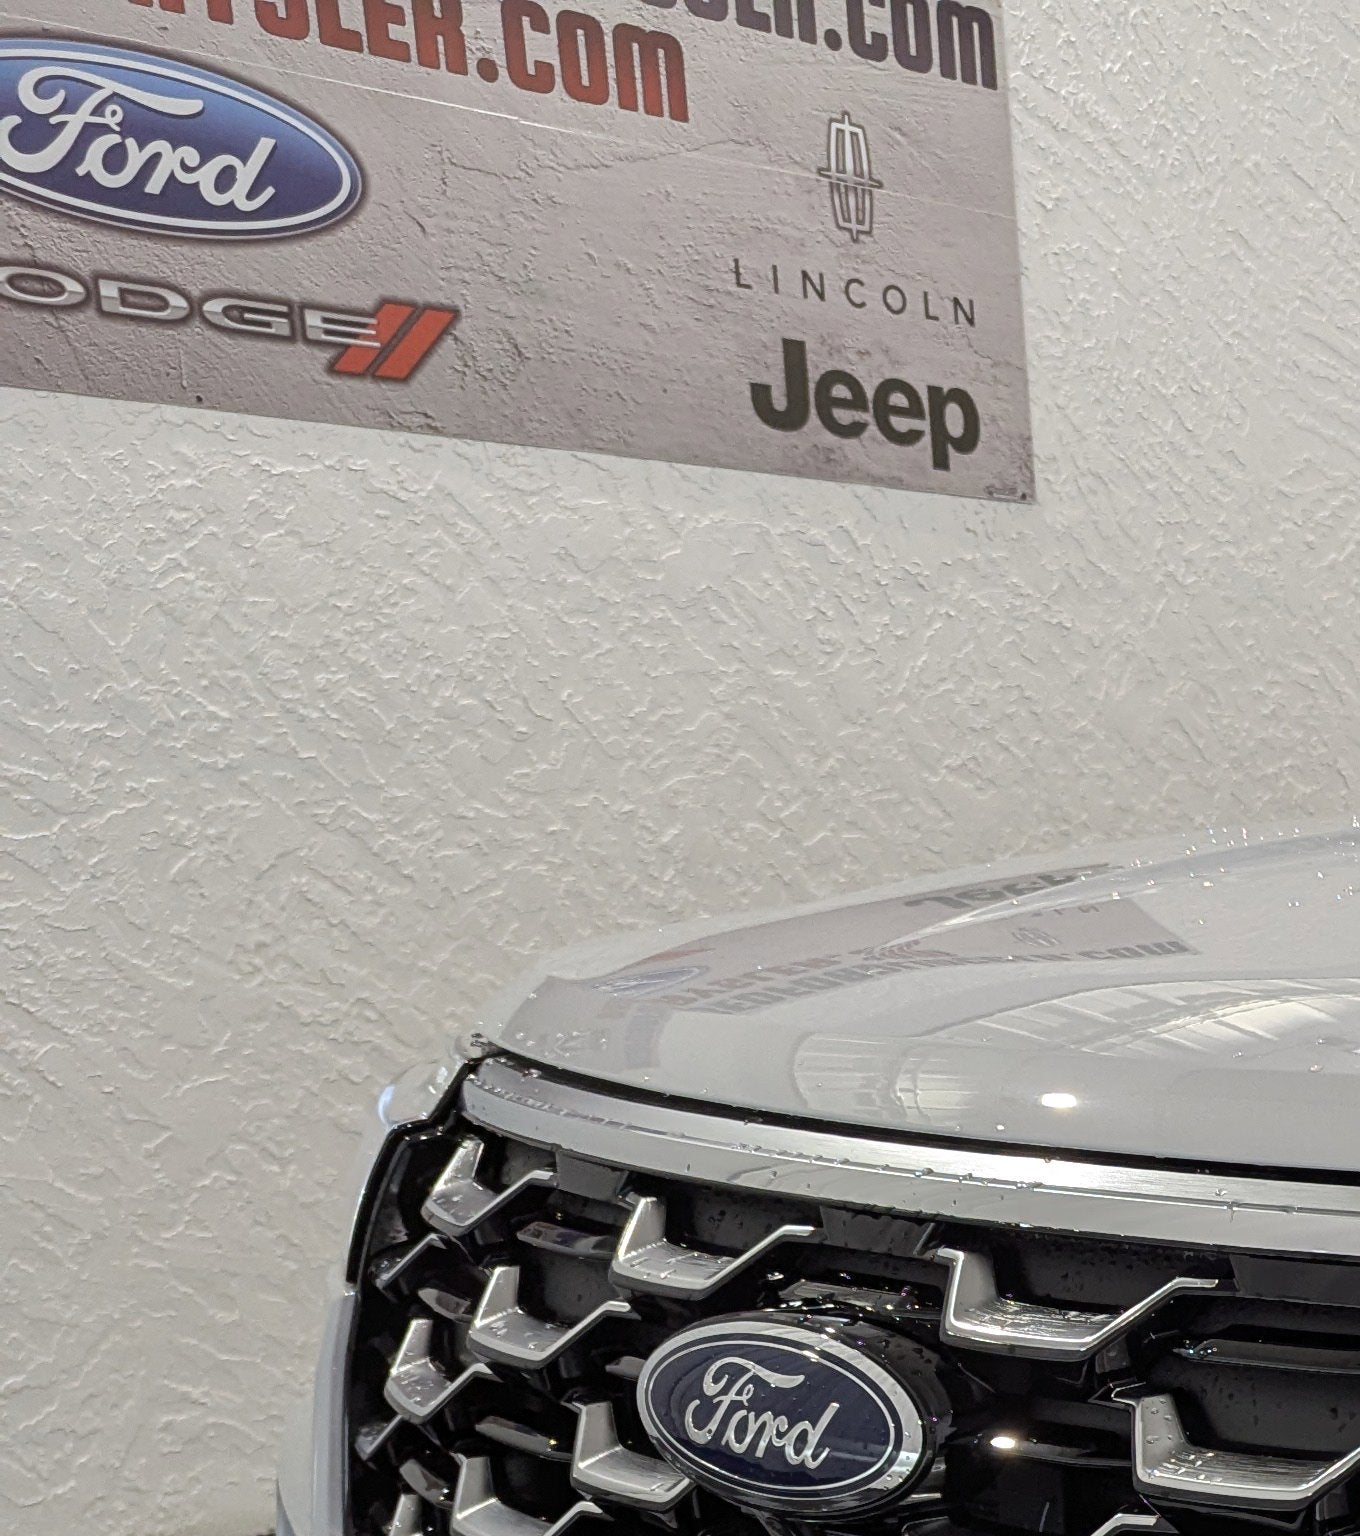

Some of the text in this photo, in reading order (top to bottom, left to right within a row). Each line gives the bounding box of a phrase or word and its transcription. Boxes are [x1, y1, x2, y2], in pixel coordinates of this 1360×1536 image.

[128, 0, 690, 122] LER.COM
[642, 0, 997, 90] N.COM
[0, 66, 277, 212] Ford
[733, 257, 976, 328] LINCOLN
[750, 337, 981, 472] Jeep
[684, 1356, 840, 1469] Ford
